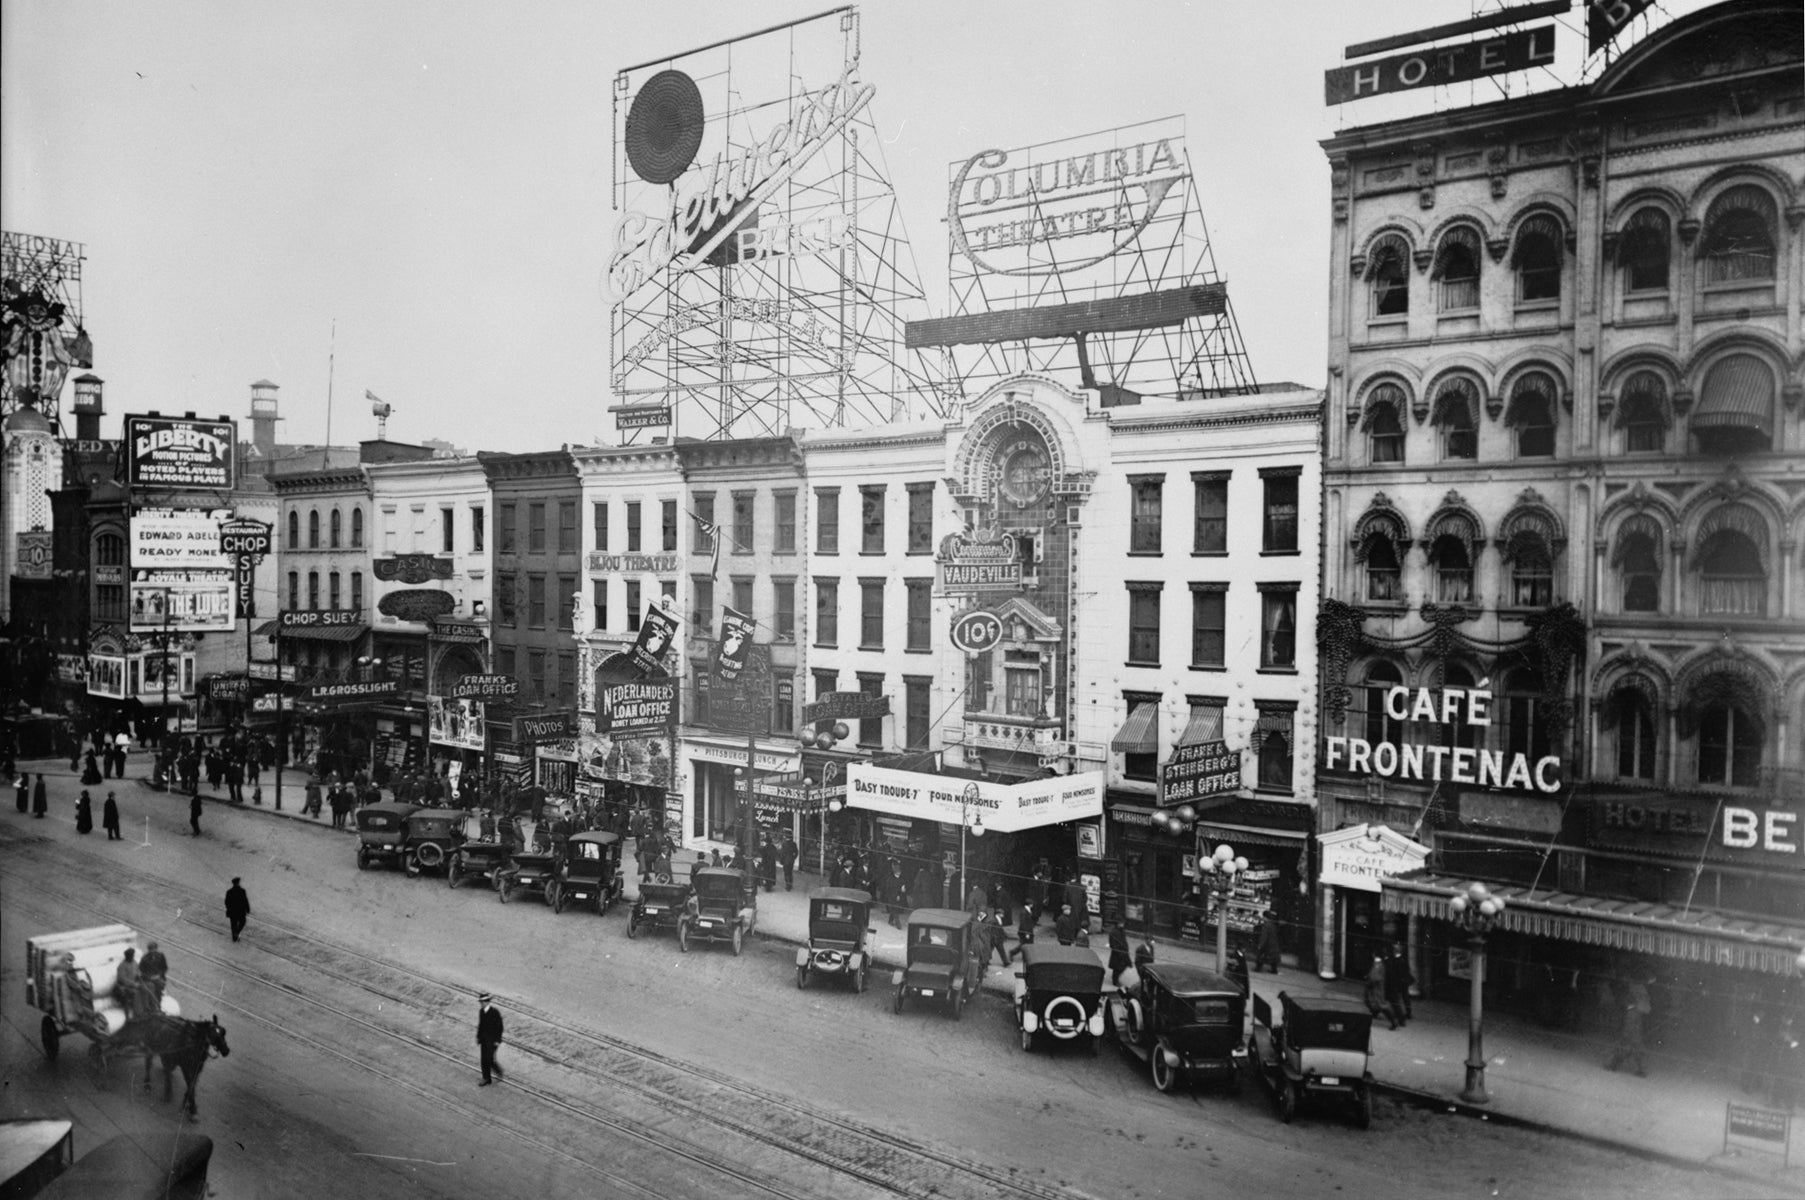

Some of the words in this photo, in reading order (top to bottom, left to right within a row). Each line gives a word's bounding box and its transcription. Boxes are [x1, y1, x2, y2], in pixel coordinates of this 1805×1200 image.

[1352, 32, 1553, 95] HOTEL
[948, 138, 1186, 252] COLUMBIA
[975, 201, 1134, 251] THEATRE
[136, 429, 228, 460] LIBERTY
[152, 451, 178, 460] MOTION
[179, 452, 213, 462] PICTURES
[140, 464, 177, 474] NOTED
[178, 466, 226, 475] PLAYERS
[149, 473, 193, 482] FAMOUS
[193, 474, 226, 484] PLAYS
[139, 531, 183, 541] EDWARD
[186, 532, 219, 541] ABELE
[223, 536, 267, 552] CHOP
[139, 548, 183, 556] READY
[188, 548, 219, 557] MONE
[590, 555, 621, 571] BIJOU
[624, 555, 677, 571] THEATRE
[944, 565, 1019, 584] VAUDEVILLE
[239, 555, 250, 615] SUEY
[283, 612, 318, 625] CHOP
[323, 611, 358, 625] SUEY
[964, 621, 997, 643] 10¢
[453, 684, 480, 697] LOAN
[482, 682, 518, 696] OFFICE
[613, 704, 638, 720] LOAN
[639, 701, 671, 716] OFFICE
[1386, 676, 1493, 726] CAFÉ
[524, 719, 564, 736] PHOTOS
[705, 748, 748, 761] PITTSBURGH
[755, 754, 777, 765] LUNCH
[1180, 743, 1215, 762] FRANK
[1165, 754, 1238, 779] STEINBERG'S
[1325, 735, 1562, 793] FRONTENAC
[1164, 779, 1194, 801] LOAN
[1197, 771, 1240, 794] OFFICE
[1605, 802, 1707, 835] HOTEL
[1722, 805, 1804, 854] BE
[1334, 861, 1393, 879] FRONTEN
